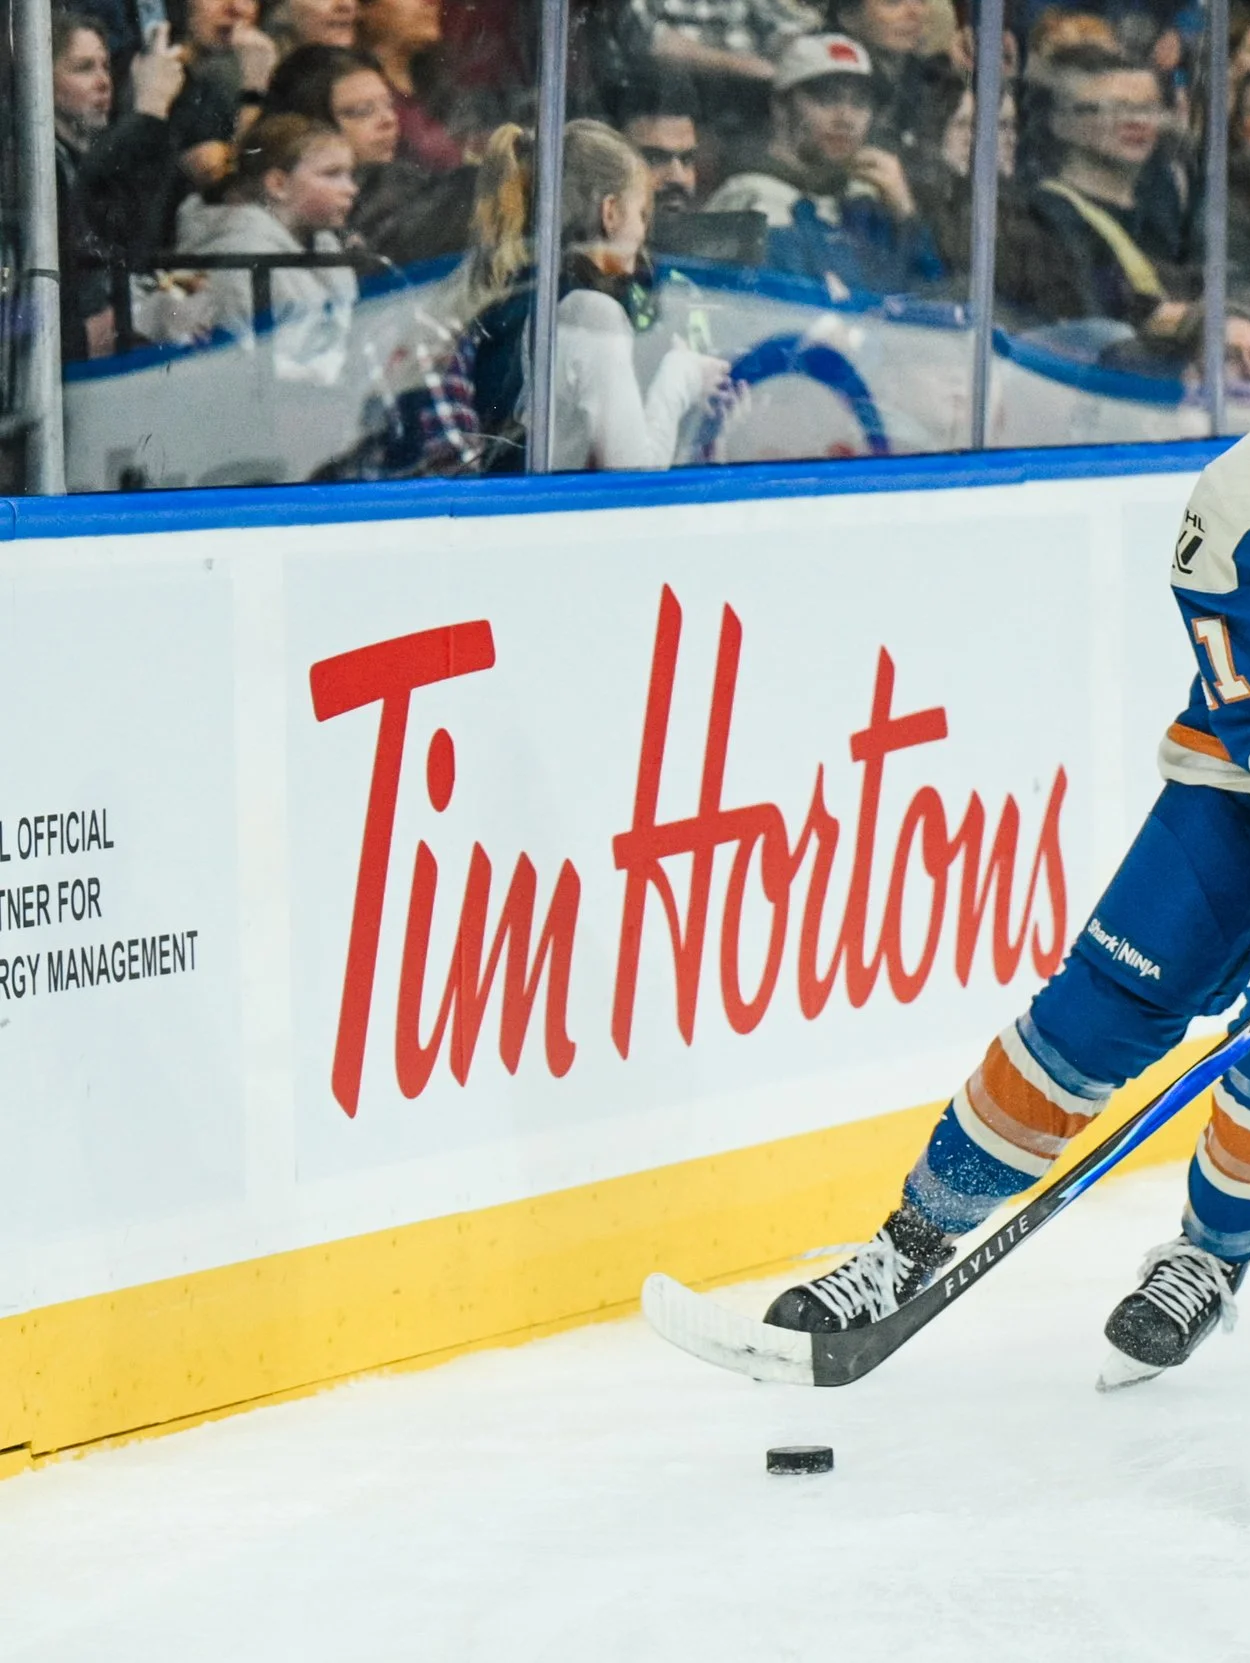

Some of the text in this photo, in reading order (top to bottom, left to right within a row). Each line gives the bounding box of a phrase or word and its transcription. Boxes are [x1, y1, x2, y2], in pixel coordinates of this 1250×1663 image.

[18, 808, 114, 860] OFFICIAL
[612, 583, 1068, 1060] Hortons
[58, 877, 102, 923] FOR
[309, 619, 581, 1118] Tim
[48, 930, 198, 993] MANAGEMENT
[944, 1214, 1030, 1298] FLYLITE
